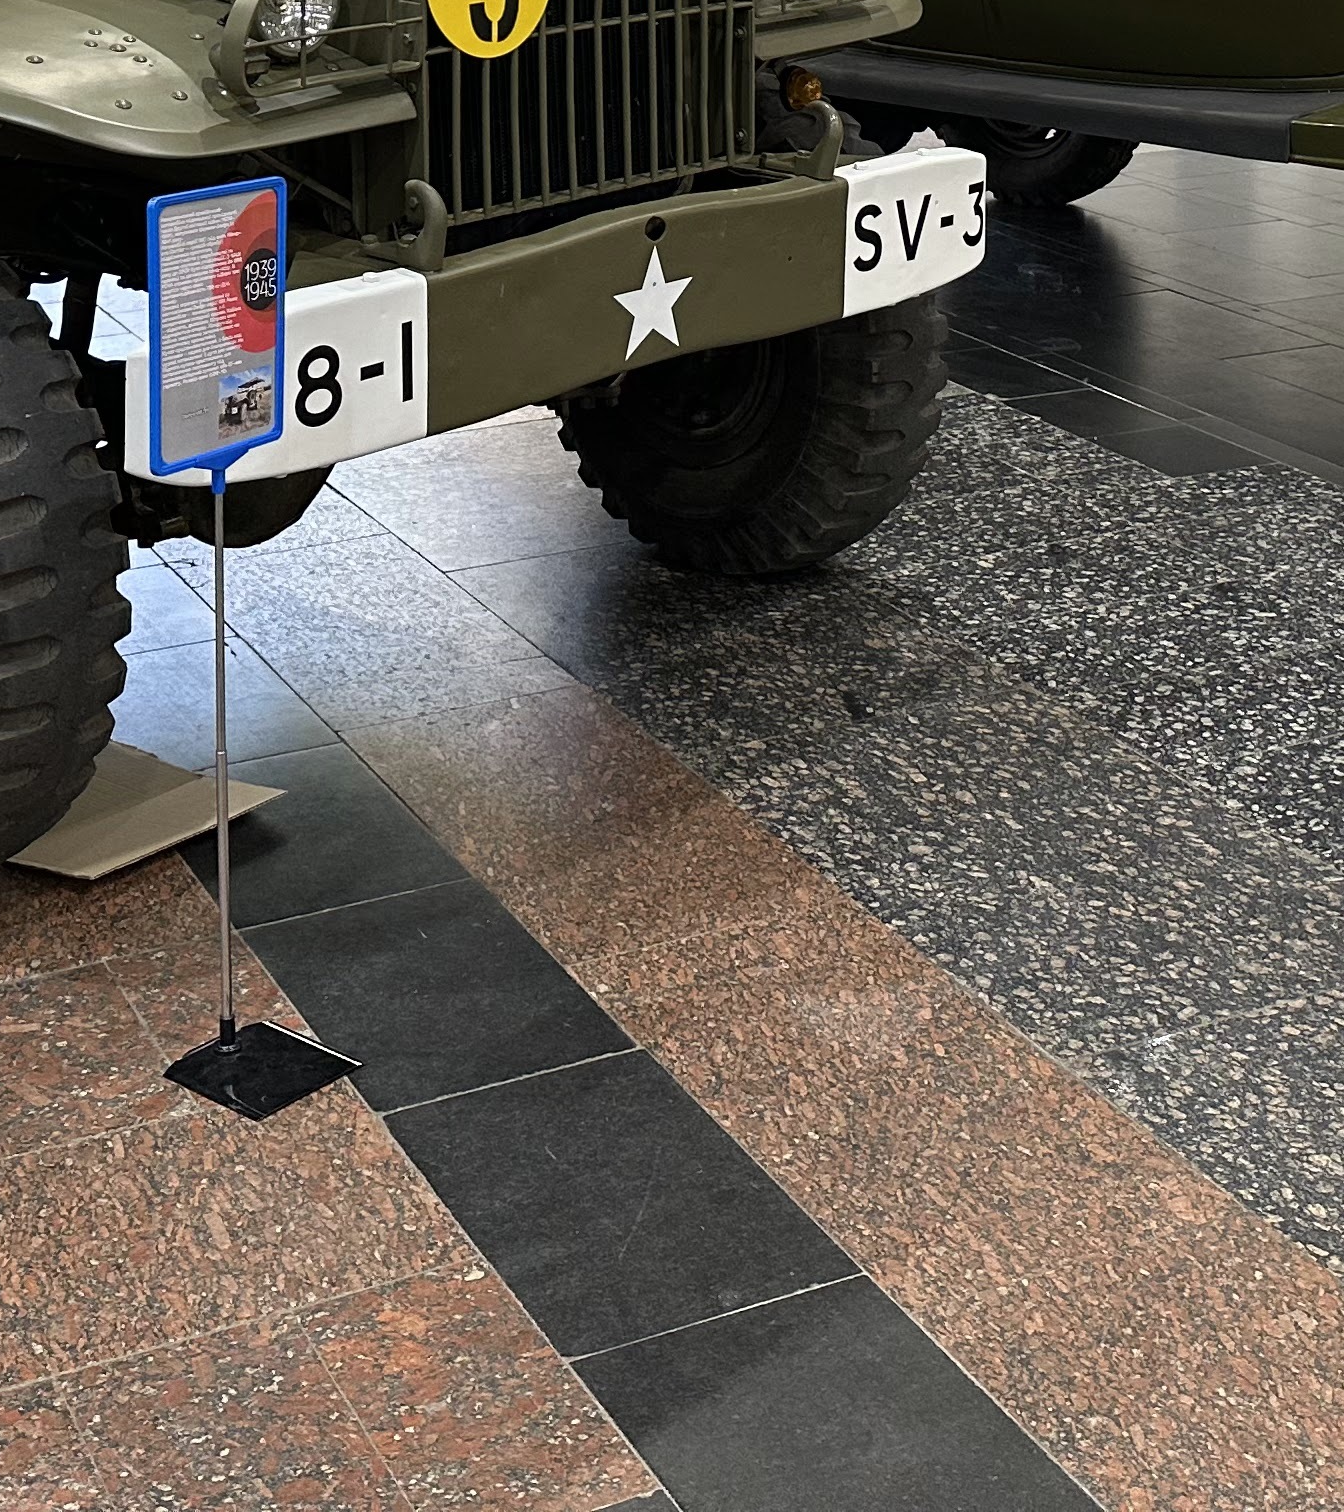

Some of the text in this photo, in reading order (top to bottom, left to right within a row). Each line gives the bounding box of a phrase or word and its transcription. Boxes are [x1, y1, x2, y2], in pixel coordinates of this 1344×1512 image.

[853, 180, 986, 273] SV-3
[244, 257, 277, 282] 1939
[244, 277, 277, 302] 1945
